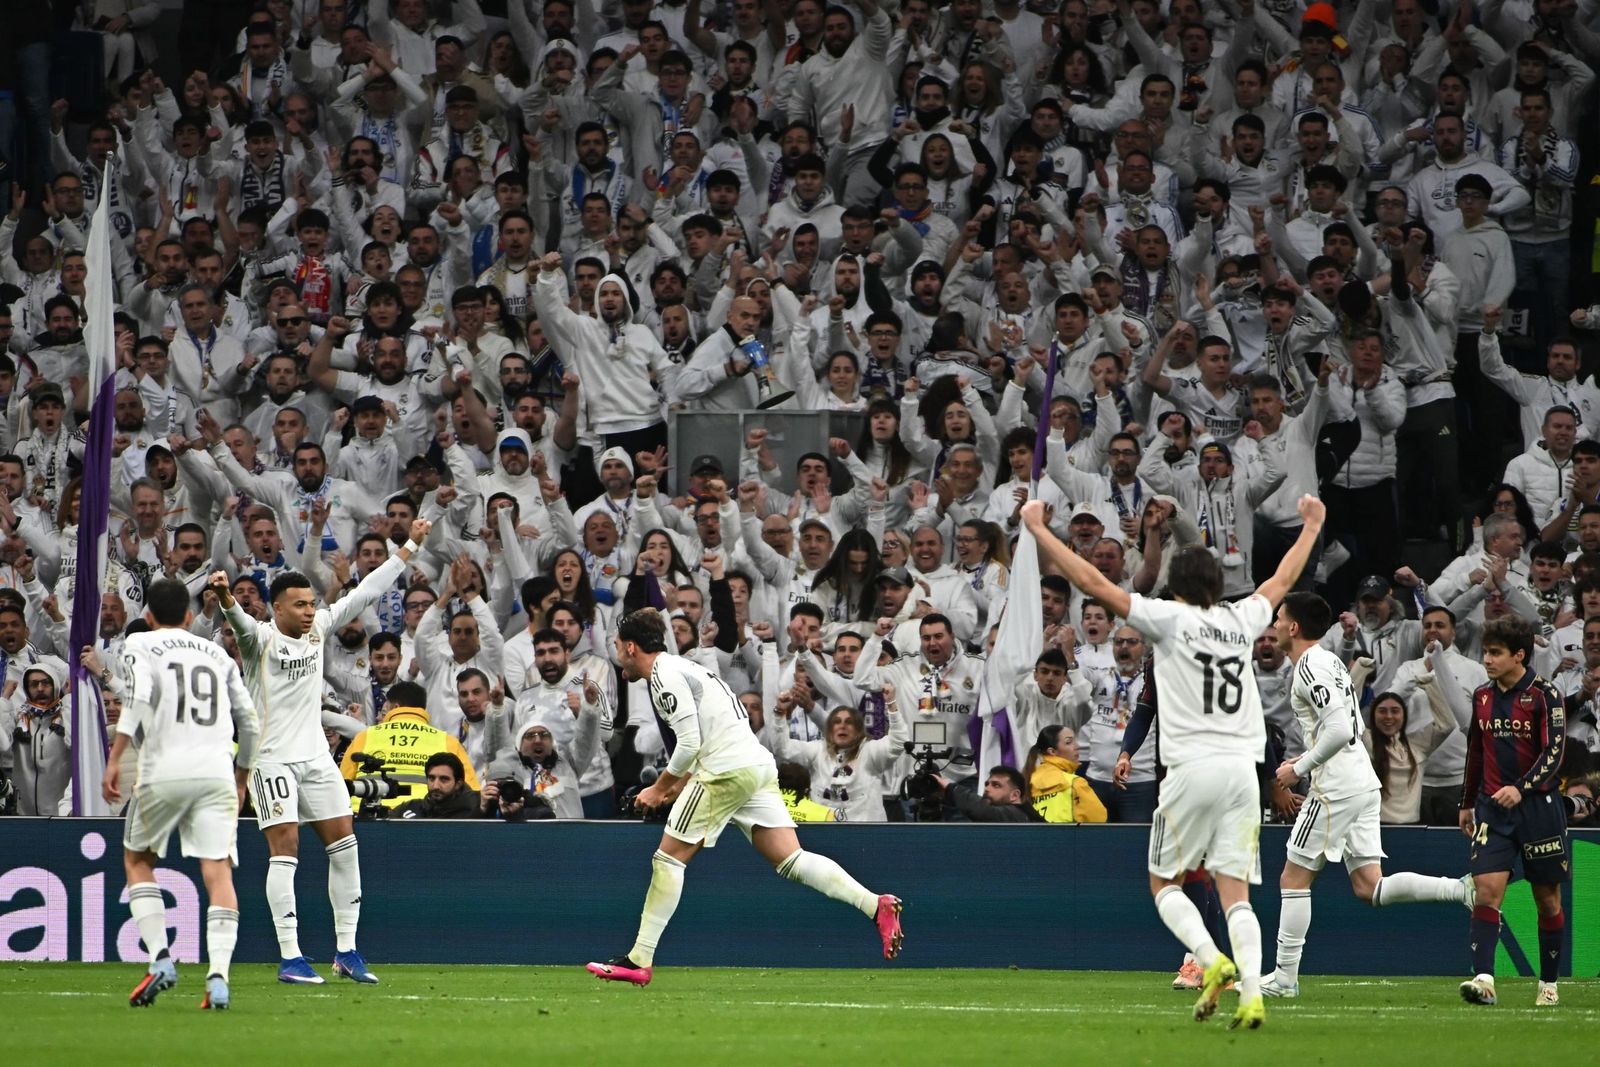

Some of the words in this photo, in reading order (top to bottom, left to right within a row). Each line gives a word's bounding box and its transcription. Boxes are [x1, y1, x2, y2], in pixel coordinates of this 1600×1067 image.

[150, 637, 166, 657] D.
[167, 661, 219, 727] 19
[1194, 652, 1245, 714] 18
[659, 692, 677, 714] hp
[1310, 684, 1331, 708] hp
[375, 721, 438, 734] STEWARD
[388, 734, 420, 747] 137
[264, 775, 290, 801] 10
